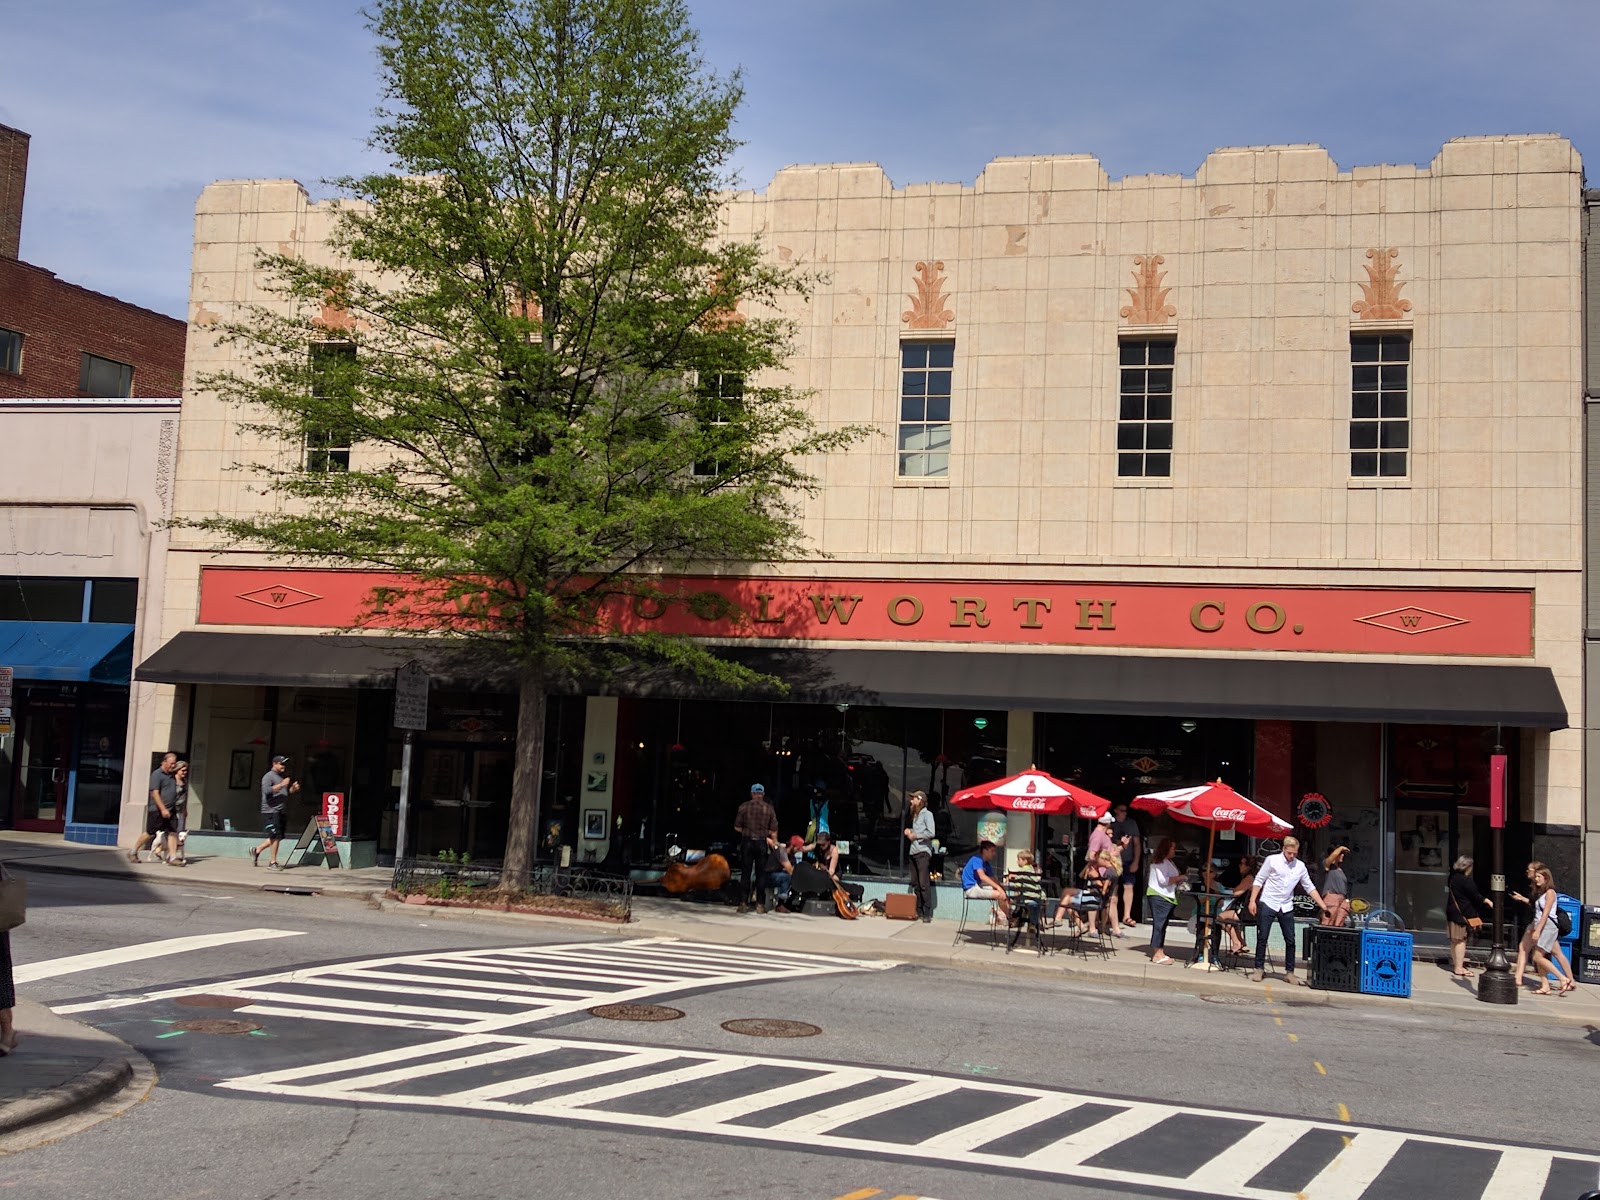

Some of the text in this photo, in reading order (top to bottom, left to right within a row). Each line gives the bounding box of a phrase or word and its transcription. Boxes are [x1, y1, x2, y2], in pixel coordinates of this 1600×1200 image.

[271, 592, 287, 603] W
[557, 591, 1118, 631] OOLWORTH
[1190, 600, 1305, 636] CO.
[1400, 614, 1422, 627] W
[1303, 792, 1324, 801] SODA
[1297, 813, 1333, 829] FOUNTAIN
